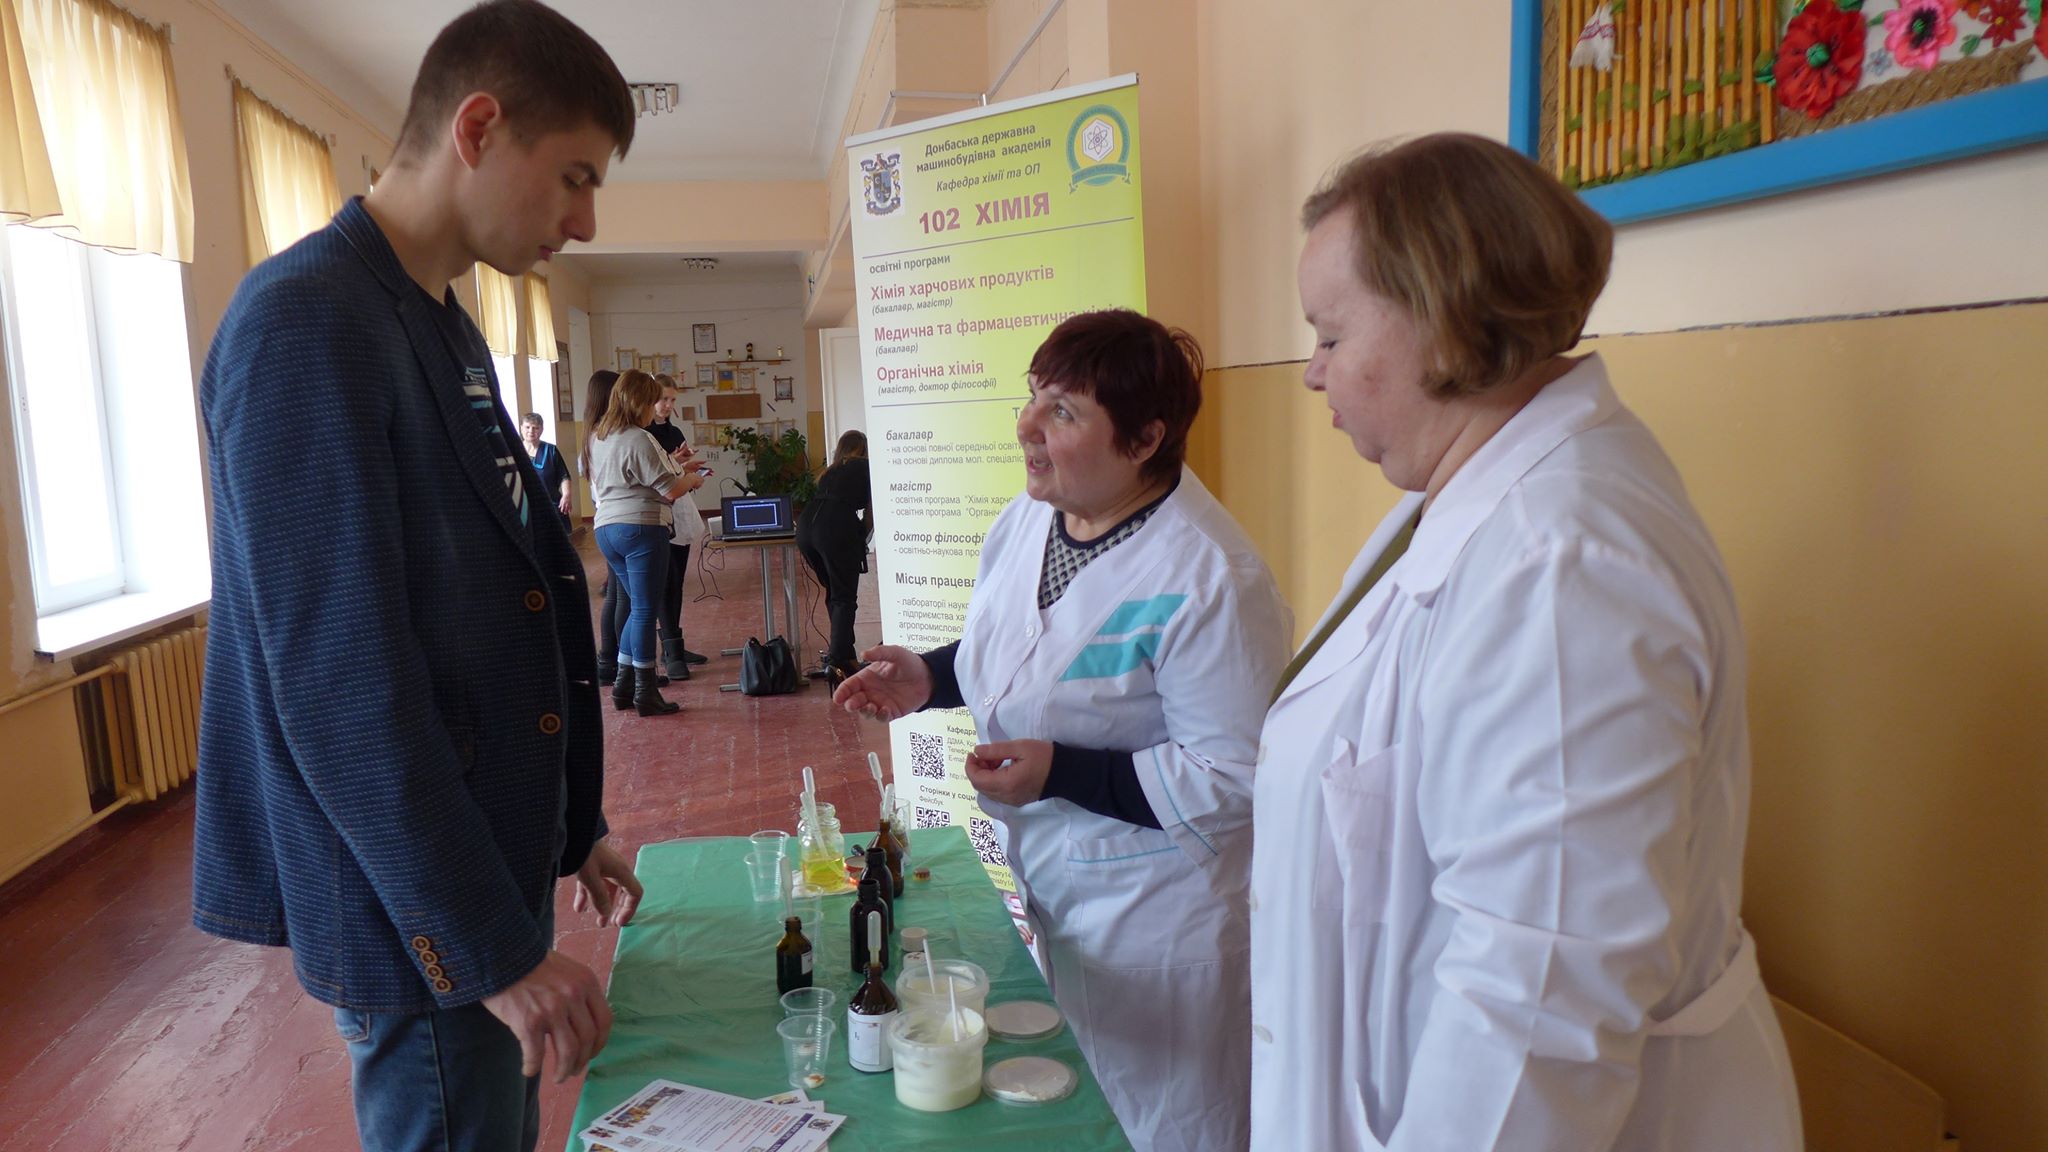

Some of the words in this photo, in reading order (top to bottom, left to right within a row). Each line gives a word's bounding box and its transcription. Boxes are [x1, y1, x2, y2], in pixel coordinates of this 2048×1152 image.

[925, 136, 980, 157] Донбаська
[981, 124, 1036, 145] державна
[916, 148, 996, 173] машинобудівна
[1001, 137, 1052, 156] академія
[936, 175, 980, 192] Кафедра
[982, 169, 1004, 184] хімії
[1006, 168, 1022, 178] та
[1024, 162, 1042, 176] ОП
[919, 207, 960, 234] 102
[975, 192, 1050, 226] ХІМІЯ
[869, 260, 902, 275] освітні
[904, 254, 951, 271] програми
[871, 283, 905, 301] Хімія
[909, 277, 976, 298] харчових
[979, 264, 1055, 290] продуктів
[872, 302, 915, 316] (бакалавр,
[917, 296, 954, 309] магістр)
[874, 324, 934, 342] Медична
[937, 323, 953, 335] та
[875, 343, 919, 357] (бакалавр)
[876, 363, 945, 383] Органічна
[948, 360, 985, 376] хімія
[878, 383, 917, 396] (магістр,
[918, 381, 950, 393] доктор
[951, 377, 998, 391] філософії)
[886, 429, 934, 442] бакалавр
[891, 445, 902, 453] на
[903, 443, 928, 453] основі
[928, 442, 954, 453] повної
[955, 441, 996, 453] середньої
[892, 457, 902, 465] на
[903, 454, 928, 465] основі
[929, 454, 964, 466] диплома
[965, 455, 984, 464] мол.
[889, 480, 932, 493] магістр
[895, 495, 923, 504] освітня
[924, 495, 961, 505] програма
[896, 507, 924, 517] освітня
[925, 507, 962, 518] програма
[893, 531, 932, 544] доктор
[898, 546, 964, 557] освітньо-наукова
[895, 572, 928, 587] Місця
[902, 597, 946, 610] лабораторії
[902, 609, 954, 621] підприємства
[899, 621, 964, 633] агропромислової
[906, 632, 941, 644] установи
[947, 725, 977, 737] Кафедра
[920, 785, 951, 797] Сторінки
